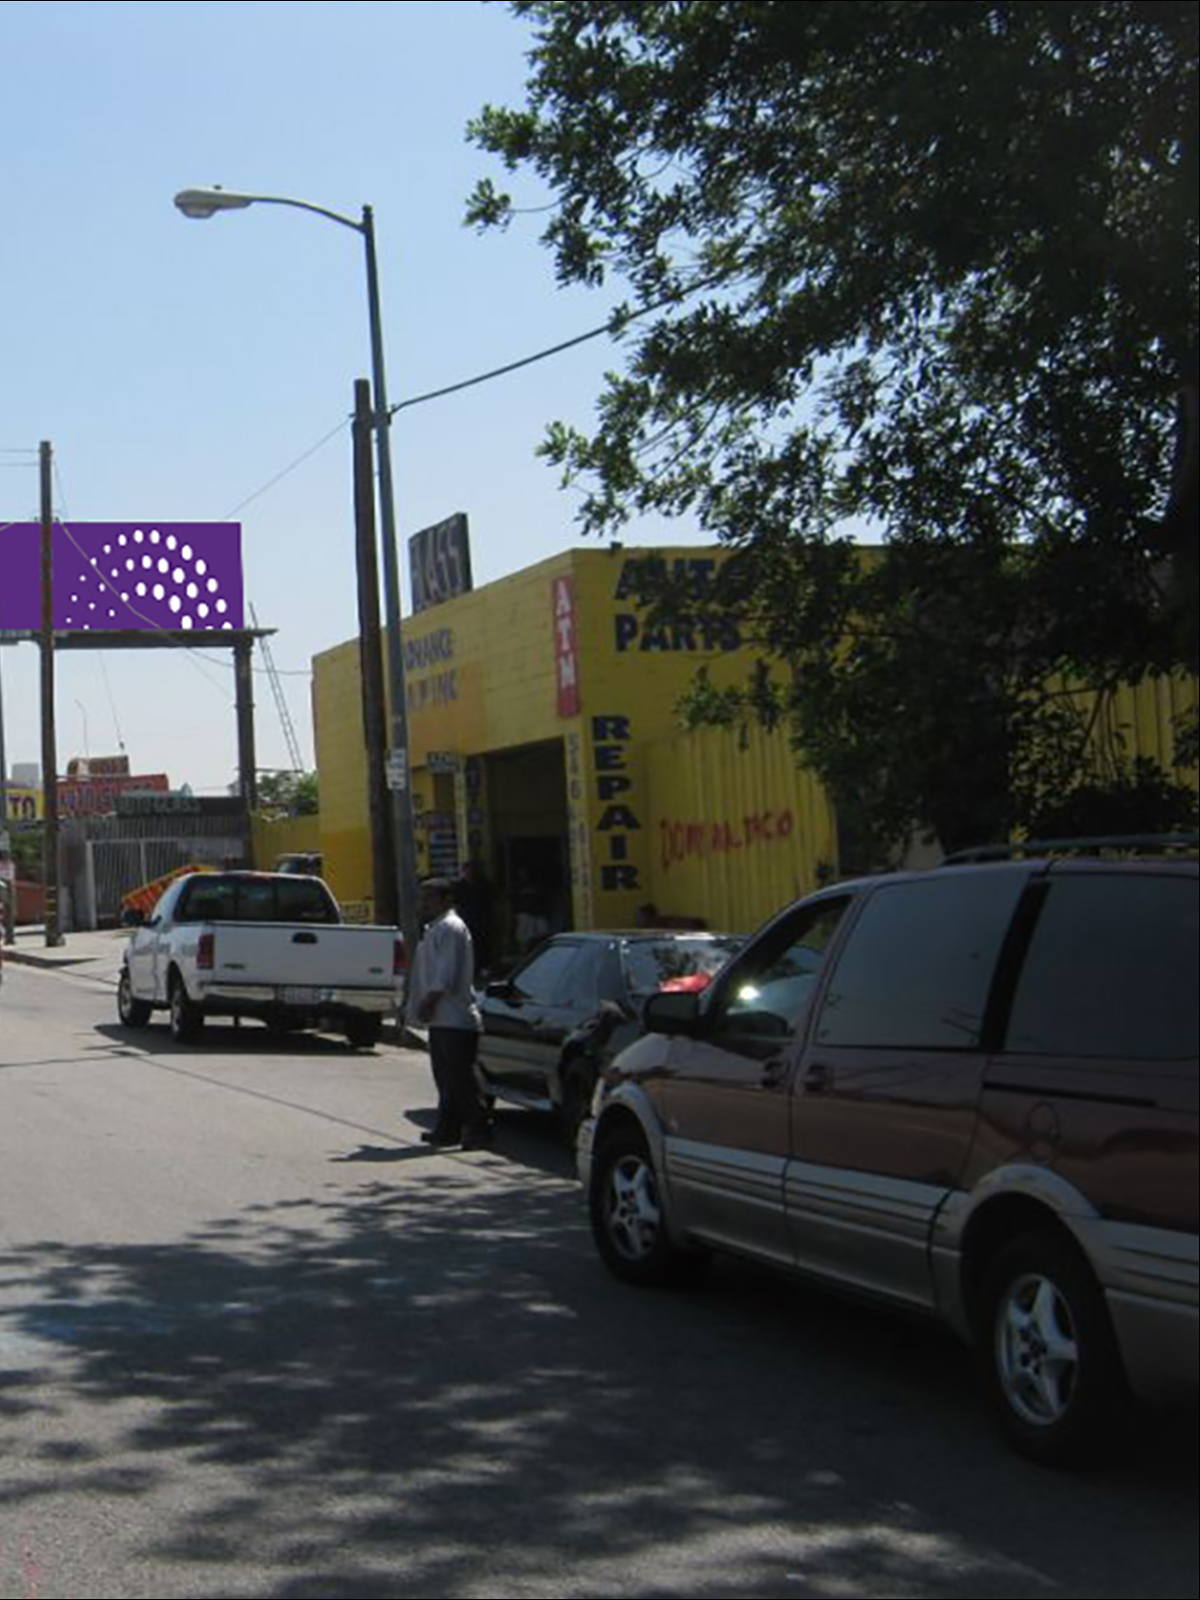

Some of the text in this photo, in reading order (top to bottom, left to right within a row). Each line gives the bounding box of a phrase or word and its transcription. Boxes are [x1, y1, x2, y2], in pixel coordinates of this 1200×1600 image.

[556, 580, 576, 687] ATM
[615, 614, 742, 653] PARTS
[592, 716, 642, 890] REPAIR
